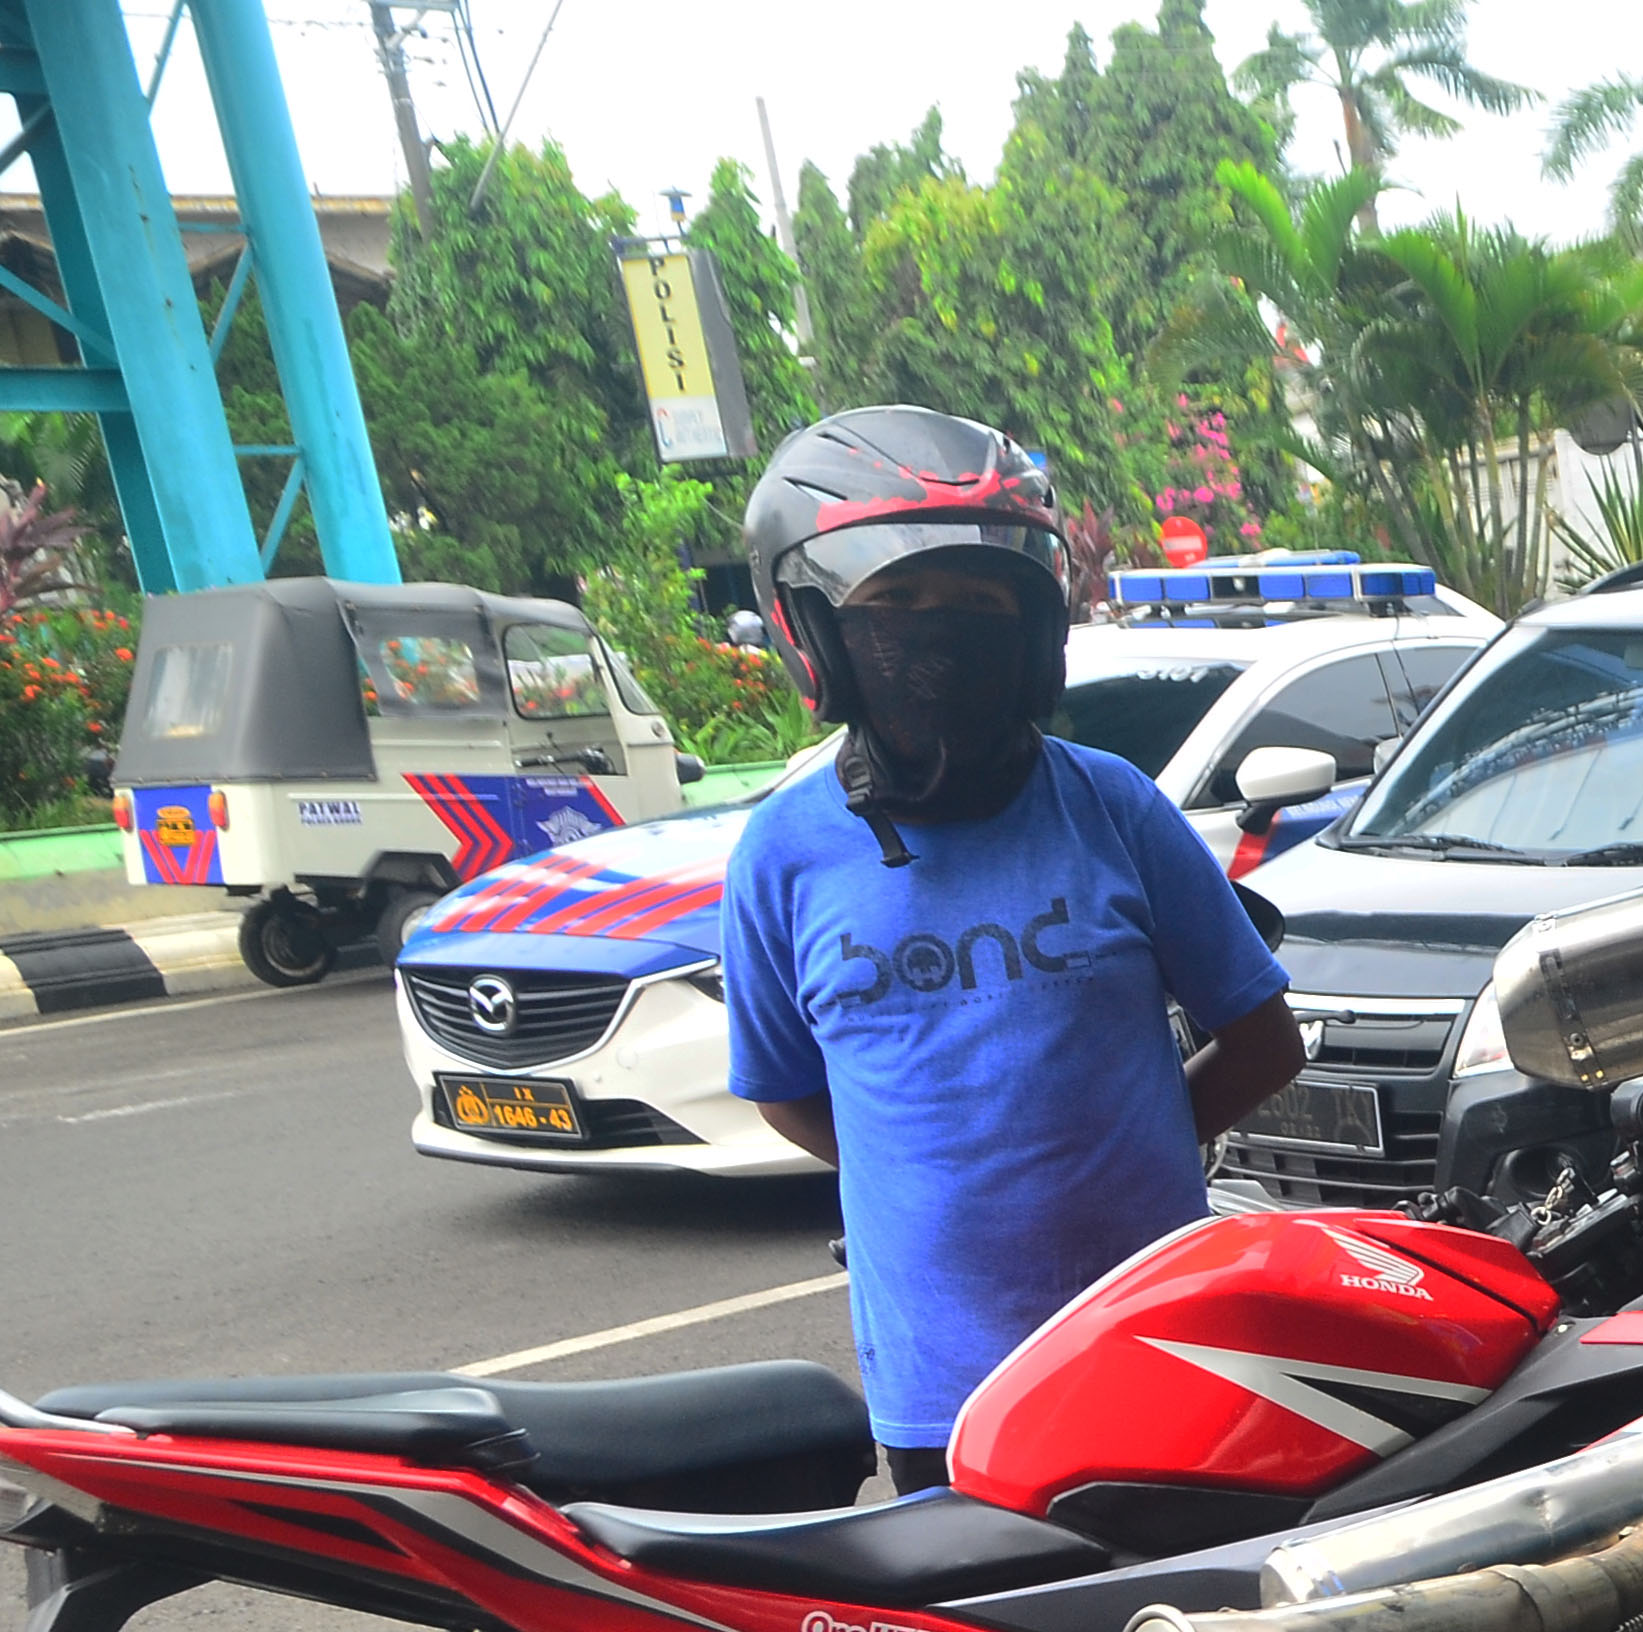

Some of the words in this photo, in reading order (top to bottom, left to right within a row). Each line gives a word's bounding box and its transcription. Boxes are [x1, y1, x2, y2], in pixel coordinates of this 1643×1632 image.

[648, 257, 687, 391] POLISI
[298, 801, 362, 817] PATWAL
[1339, 1273, 1435, 1302] HONDA
